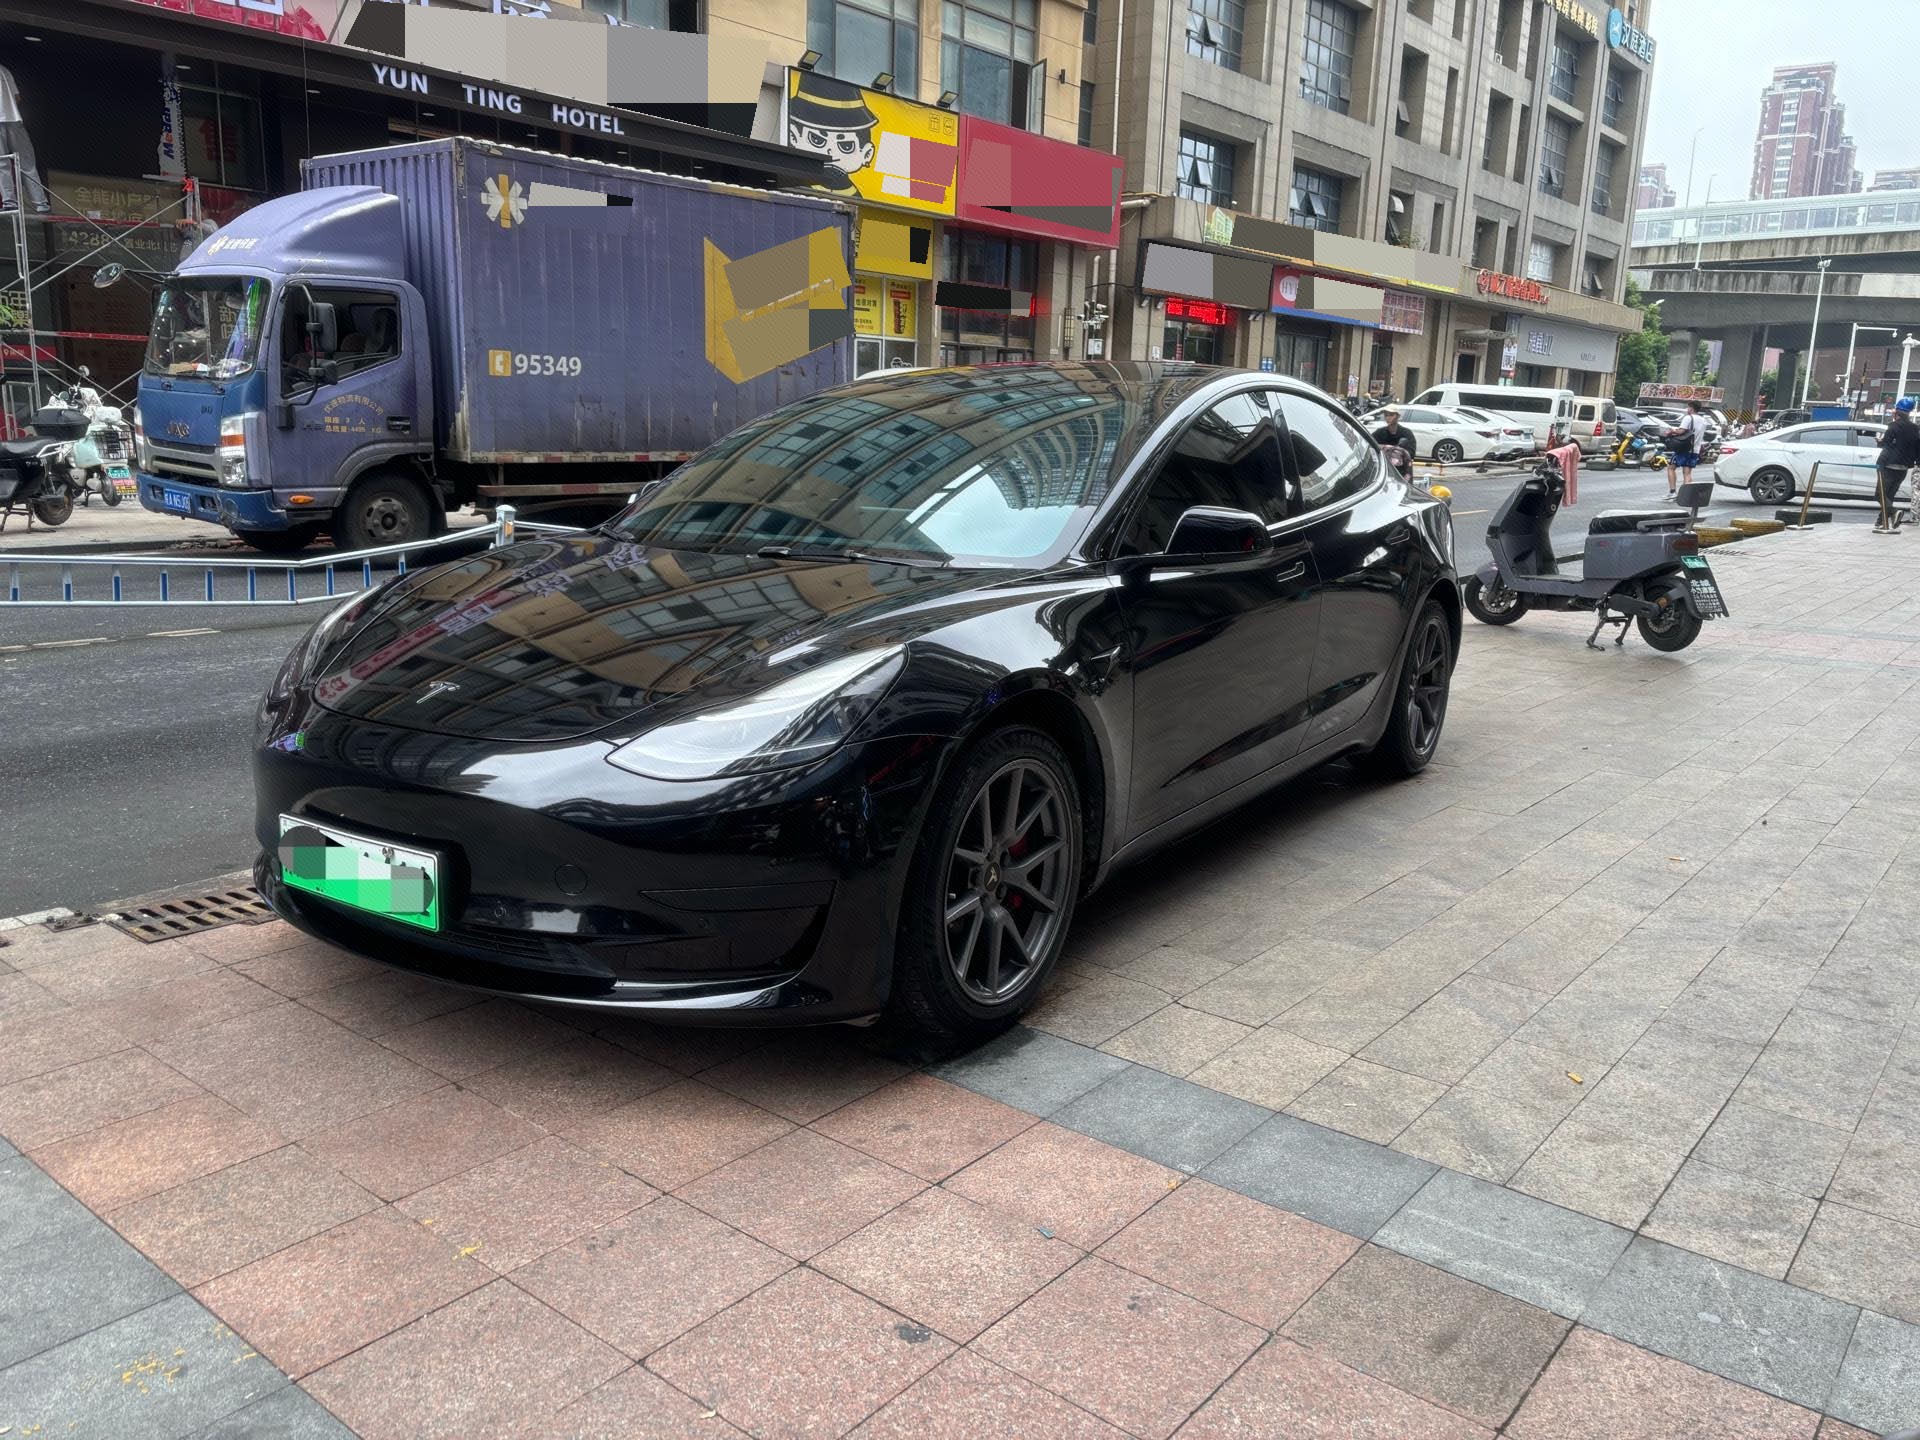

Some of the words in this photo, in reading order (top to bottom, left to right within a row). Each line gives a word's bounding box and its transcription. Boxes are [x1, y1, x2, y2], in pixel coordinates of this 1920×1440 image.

[1621, 19, 1654, 64] 汉庭酒店
[371, 63, 428, 95] YUN
[462, 83, 523, 114] TING
[552, 103, 625, 136] HOTEL
[514, 353, 582, 377] 95349
